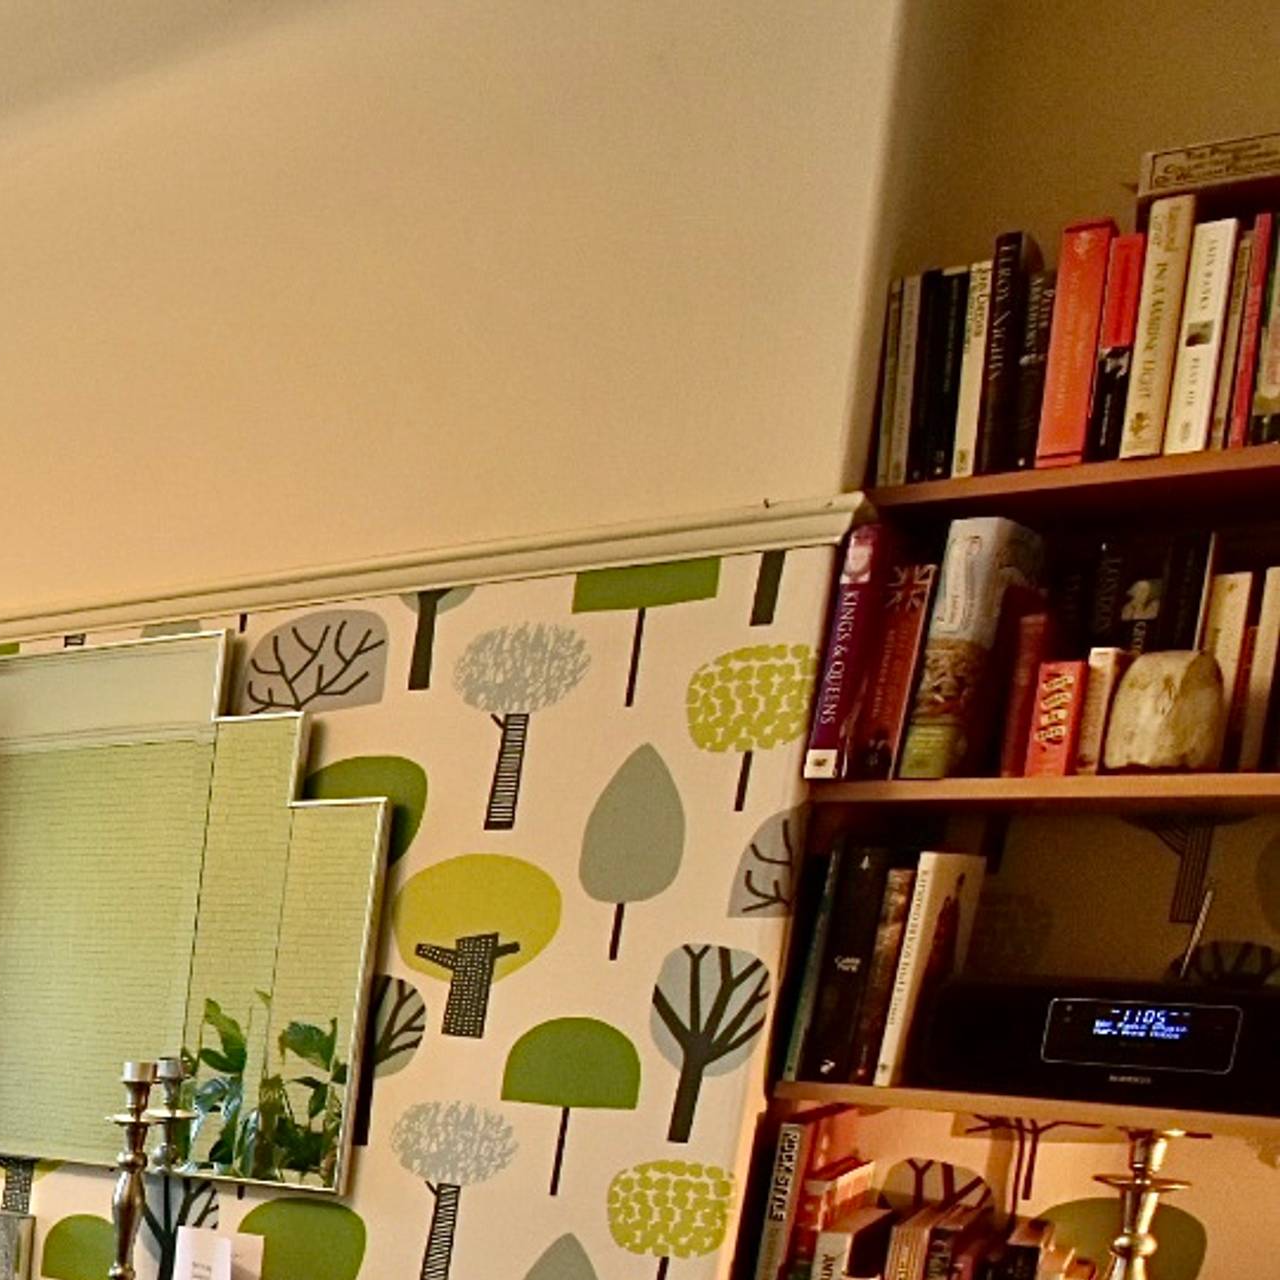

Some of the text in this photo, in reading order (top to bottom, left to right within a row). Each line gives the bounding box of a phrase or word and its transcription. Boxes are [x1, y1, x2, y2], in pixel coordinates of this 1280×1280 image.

[820, 590, 860, 725] KINGS & QUEENS
[769, 1131, 800, 1221] ROCK STYLE
